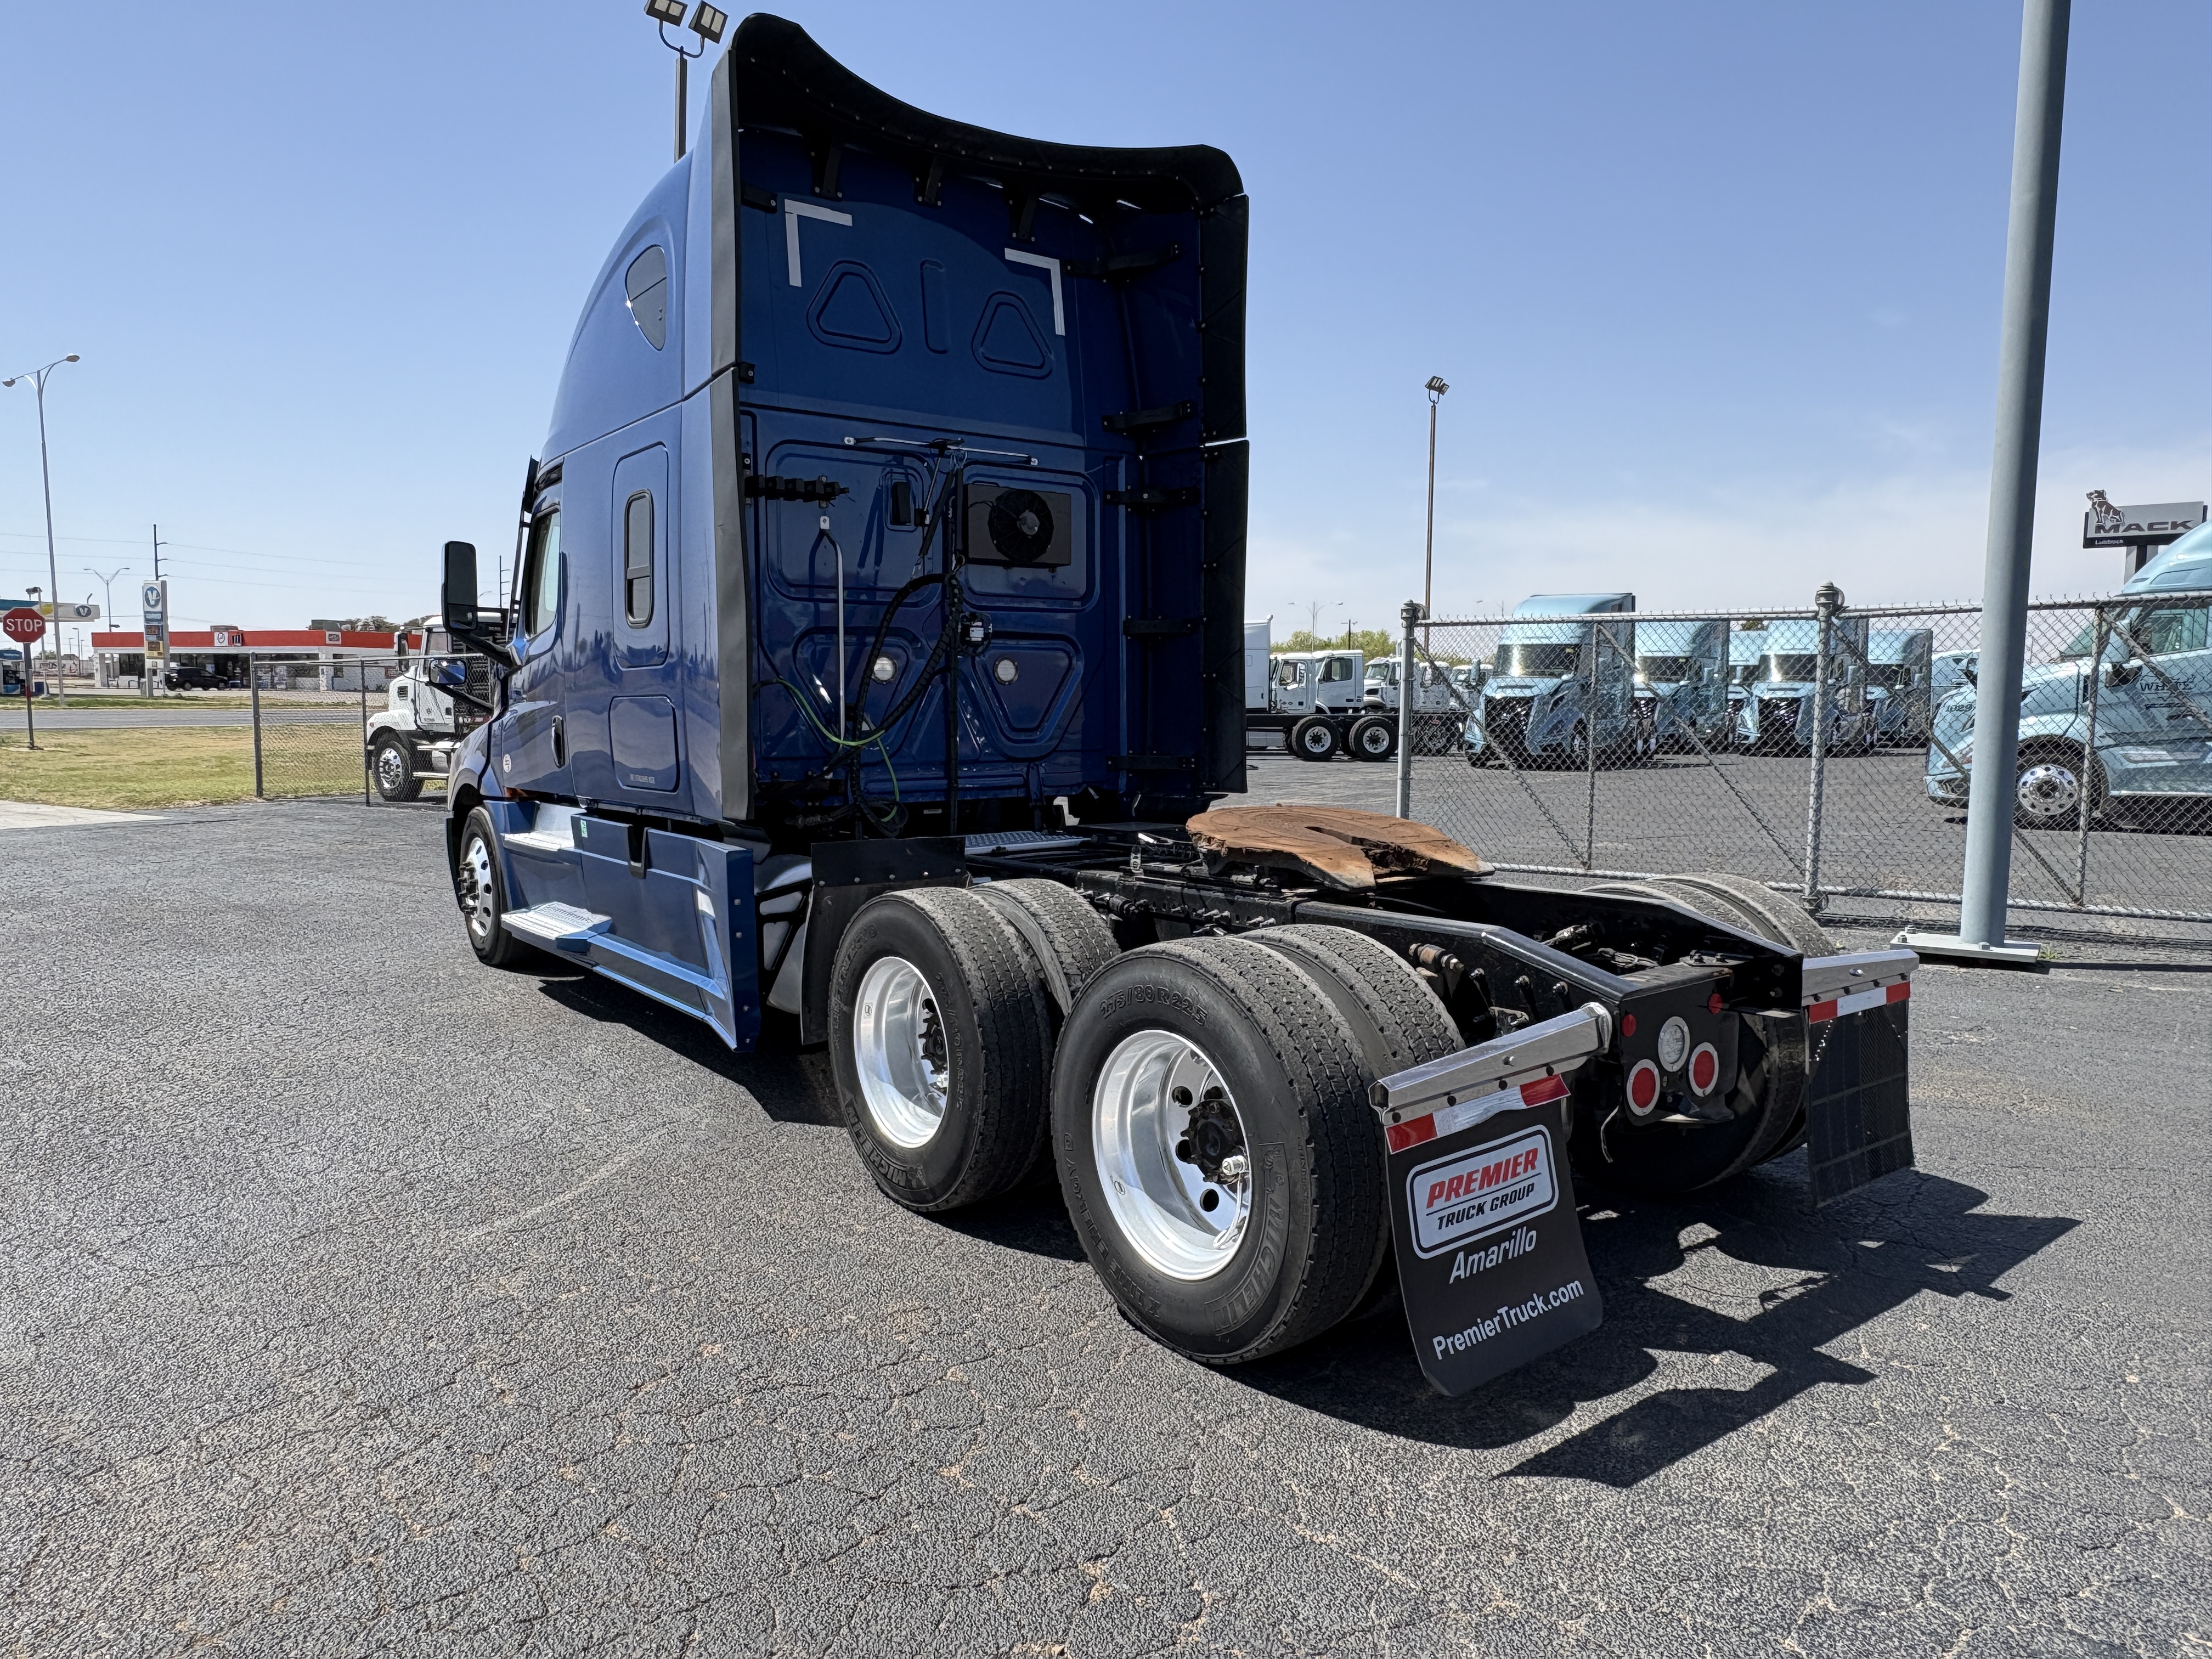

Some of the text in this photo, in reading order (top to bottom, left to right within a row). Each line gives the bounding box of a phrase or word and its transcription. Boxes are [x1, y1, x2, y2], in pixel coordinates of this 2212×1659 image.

[2095, 520, 2194, 535] MACK
[6, 618, 42, 632] STOP
[845, 1105, 906, 1187] MICHELIN
[1426, 1148, 1538, 1209] PREMIER
[1438, 1182, 1534, 1230] TRUCK GROUP
[1212, 1197, 1285, 1331] MICHELIN
[1449, 1226, 1537, 1284] Amarillo
[1432, 1280, 1584, 1360] PremierTruck.com
